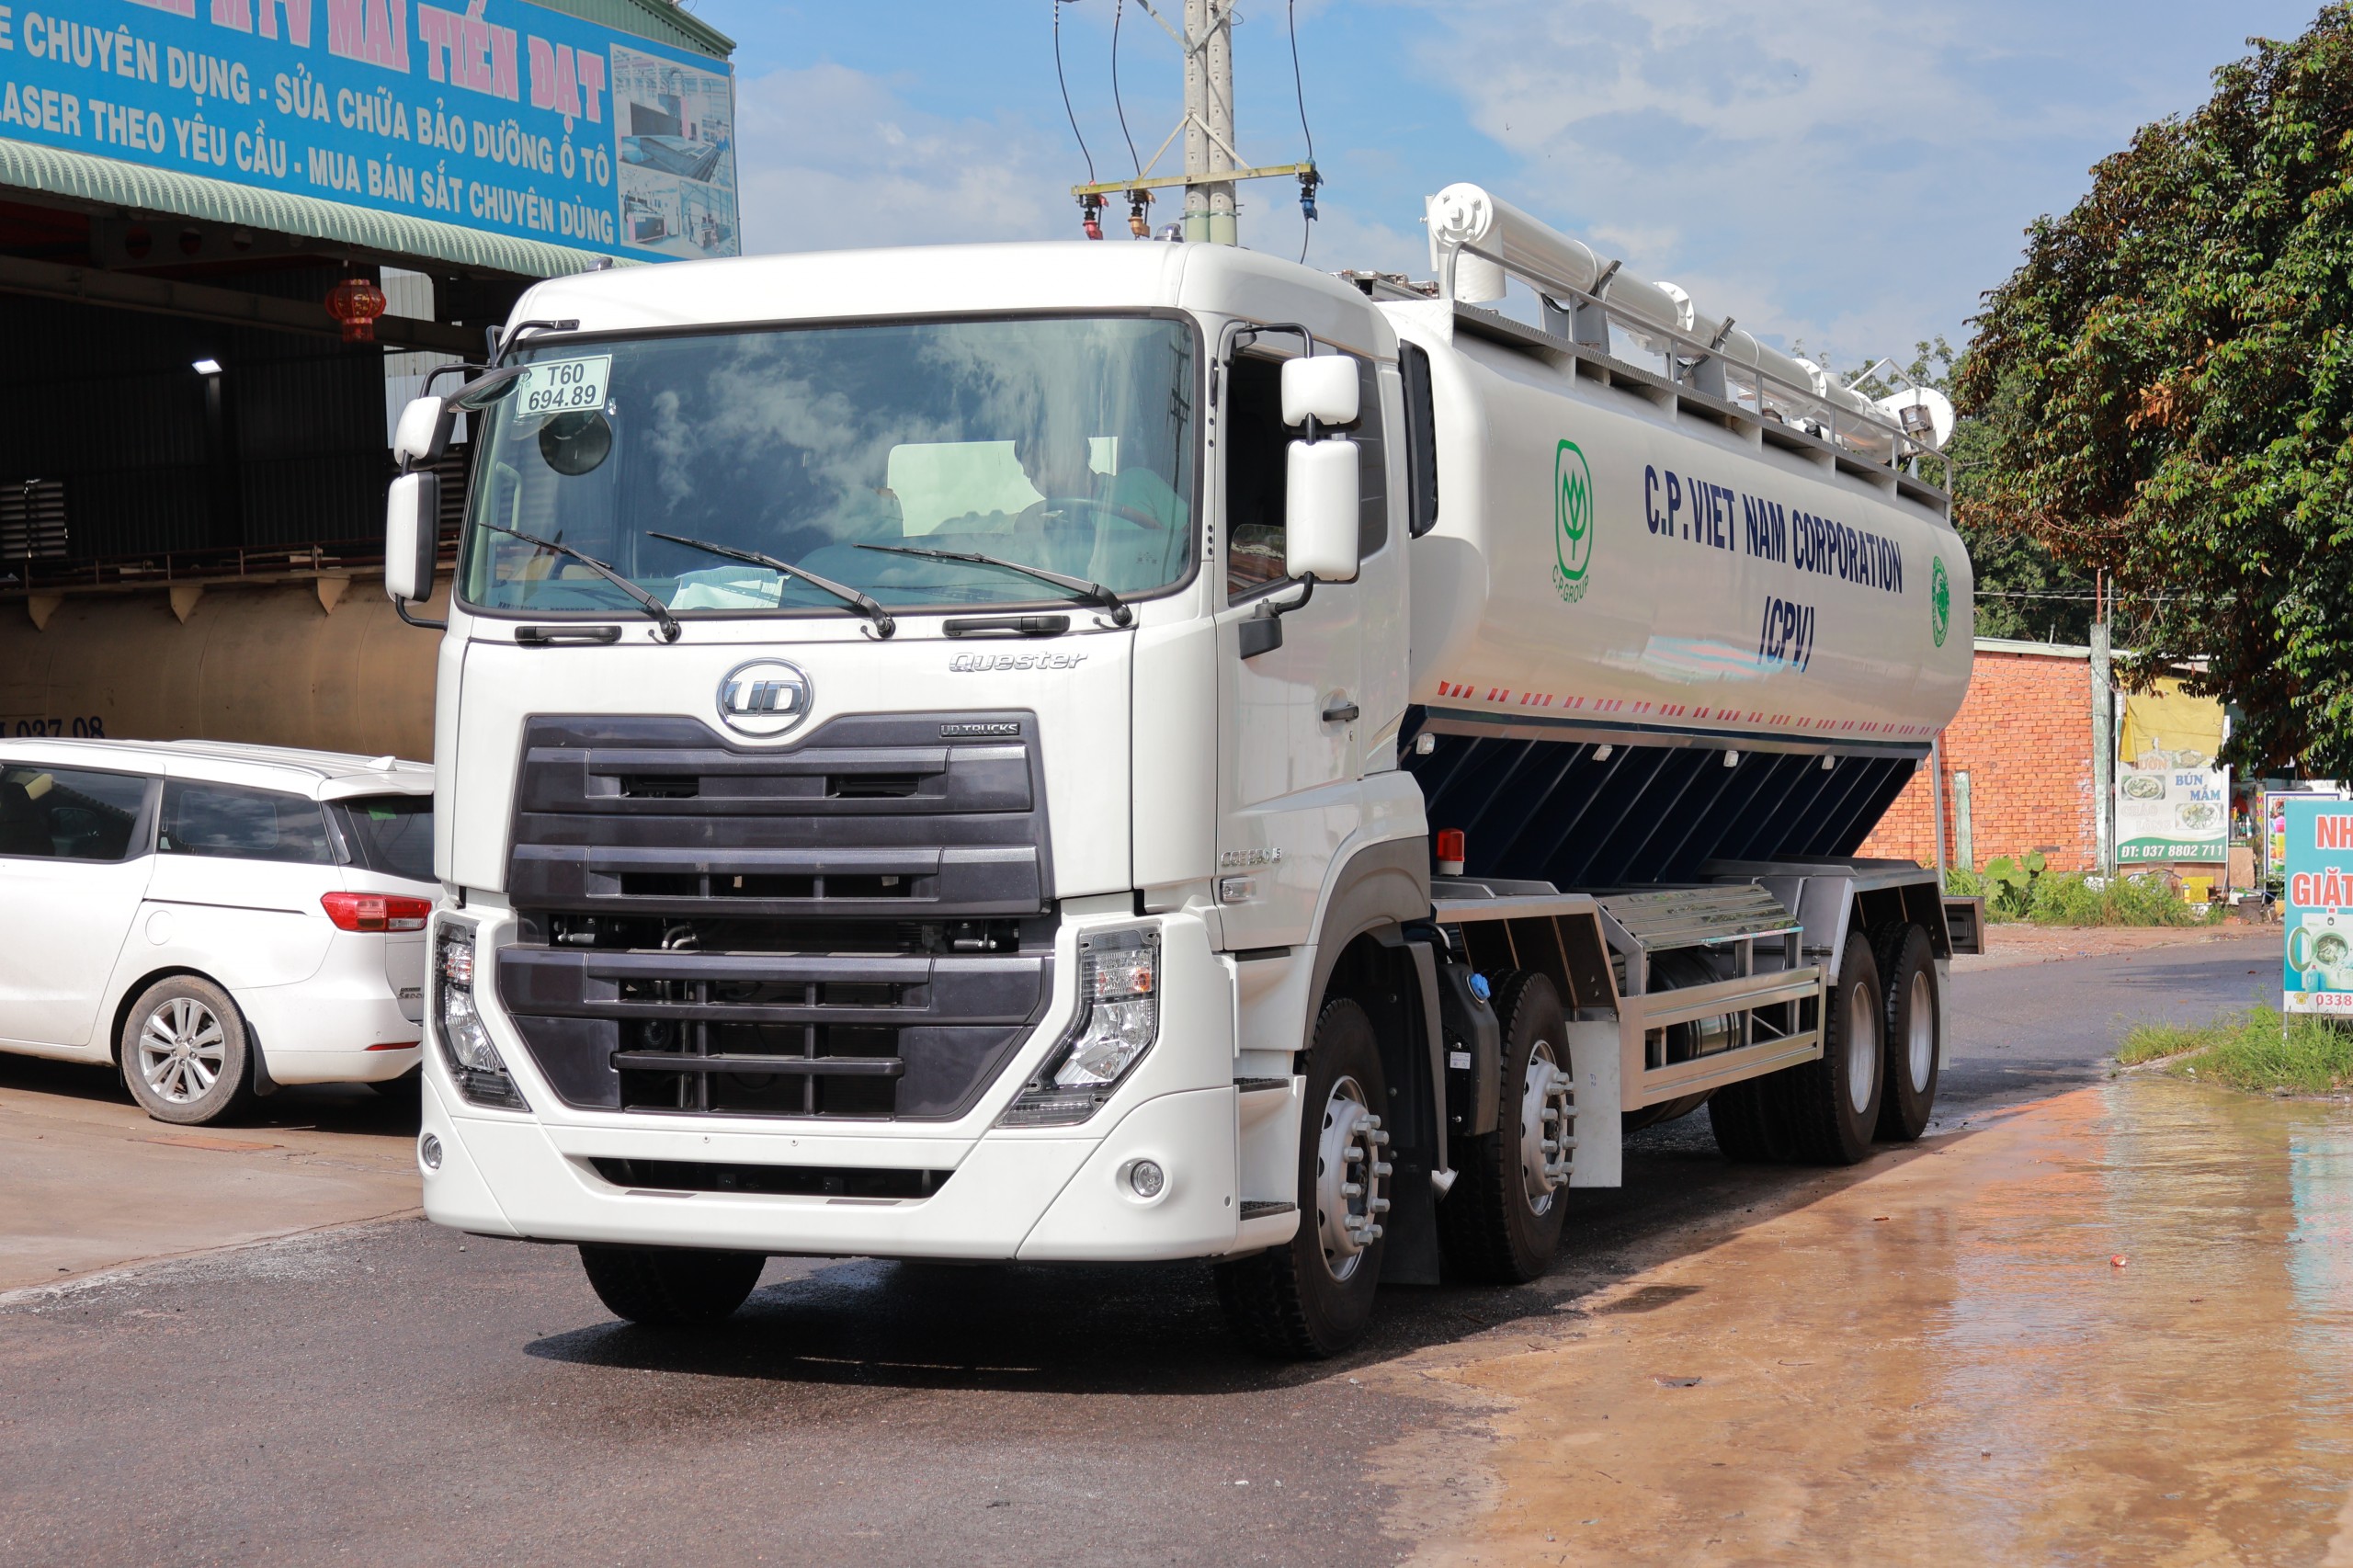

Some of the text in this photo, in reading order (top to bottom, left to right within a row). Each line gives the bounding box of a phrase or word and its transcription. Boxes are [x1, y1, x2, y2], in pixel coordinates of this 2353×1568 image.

[328, 0, 410, 74] MAI
[417, 0, 519, 102] TIẾN
[528, 34, 606, 134] ĐẠT
[23, 12, 157, 84] CHUYÊN
[167, 46, 250, 107] DỤNG
[275, 62, 331, 123] SỬA
[337, 85, 410, 141] CHỮA
[416, 97, 466, 153] BẢO
[472, 119, 554, 174] DƯỠNG
[560, 135, 575, 179] Ô
[581, 143, 610, 187] TÔ
[0, 82, 81, 137] ASER
[89, 98, 165, 153] THEO
[172, 112, 227, 166] YÊU
[234, 119, 286, 178] CẦU
[308, 147, 361, 194] MUA
[367, 153, 415, 203] BÁN
[421, 159, 462, 213] SẮT
[469, 182, 554, 233] CHUYÊN
[559, 195, 614, 245] DÙNG
[548, 363, 585, 386] T60
[529, 384, 597, 411] 694.89
[1742, 493, 1787, 563] NAM
[1791, 508, 1903, 594] CORPORATION
[1756, 596, 1815, 673] (CPV)
[949, 651, 1088, 673] Quester
[722, 680, 806, 716] UD
[940, 722, 1018, 735] UD TRUCKS
[2175, 772, 2204, 786] BÚN
[2121, 845, 2223, 858] ĐT: 037 8802 711
[2291, 867, 2353, 914] GIẶT
[2316, 994, 2352, 1006] 0338
